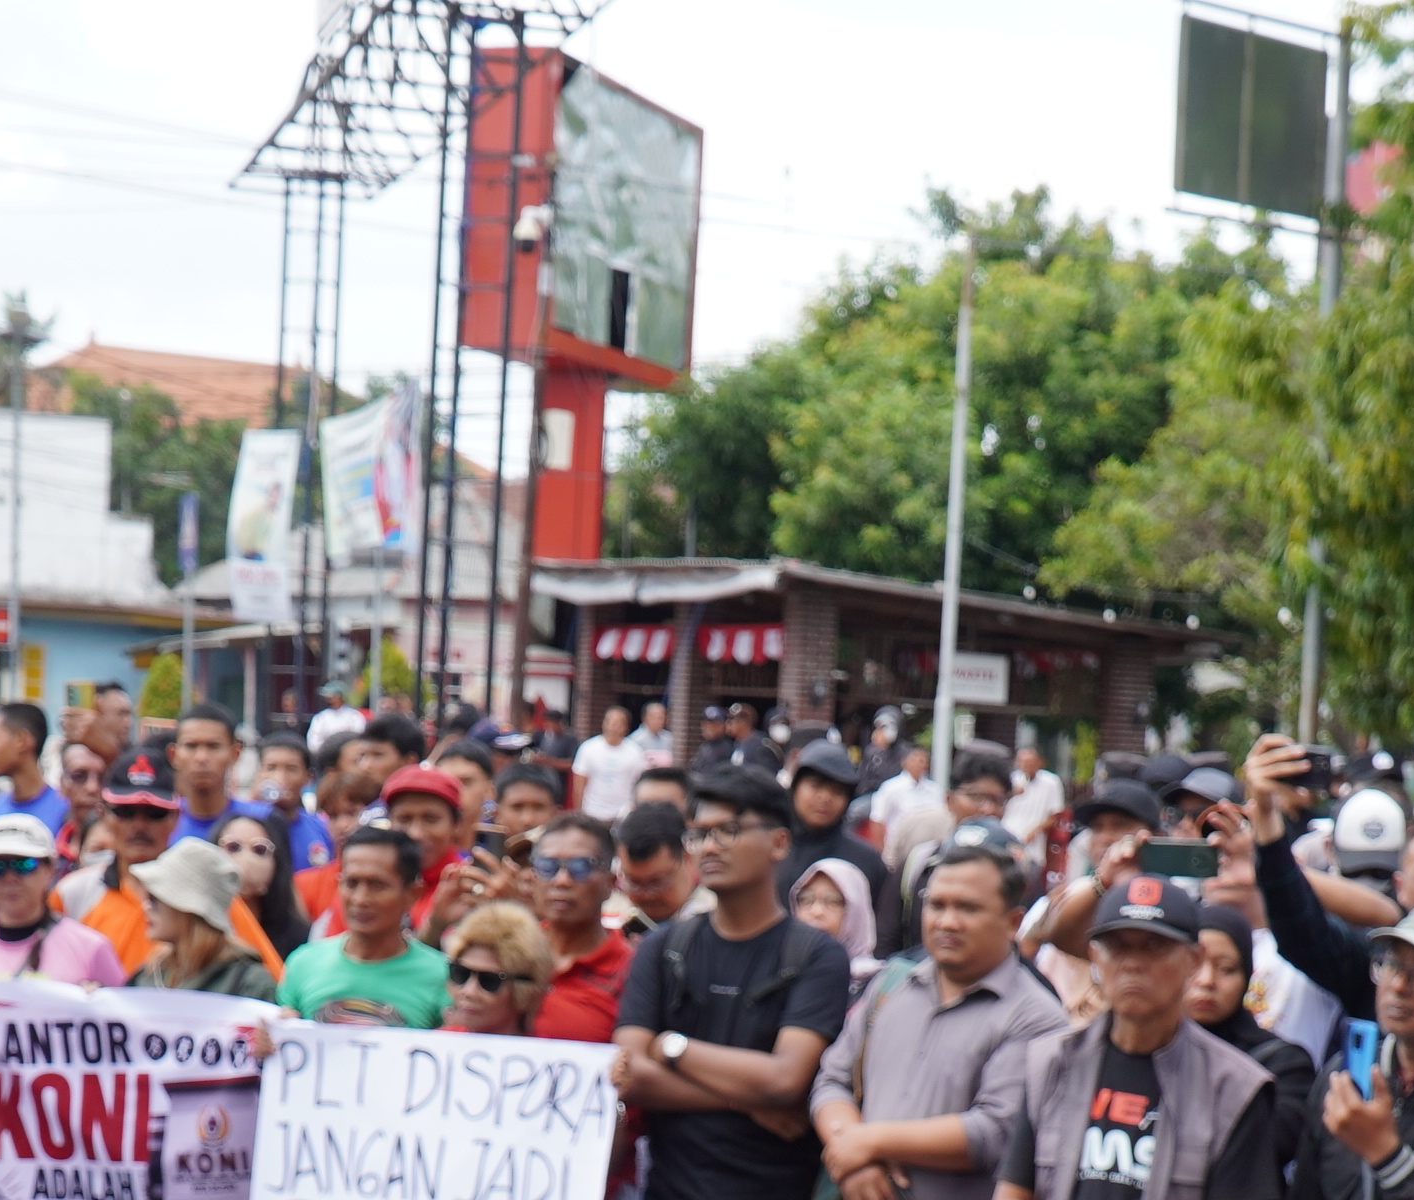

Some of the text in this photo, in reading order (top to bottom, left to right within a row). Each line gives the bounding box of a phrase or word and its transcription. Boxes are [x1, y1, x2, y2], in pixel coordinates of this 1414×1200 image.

[277, 1039, 608, 1146] PLT DISPORA
[175, 1151, 250, 1175] KONI
